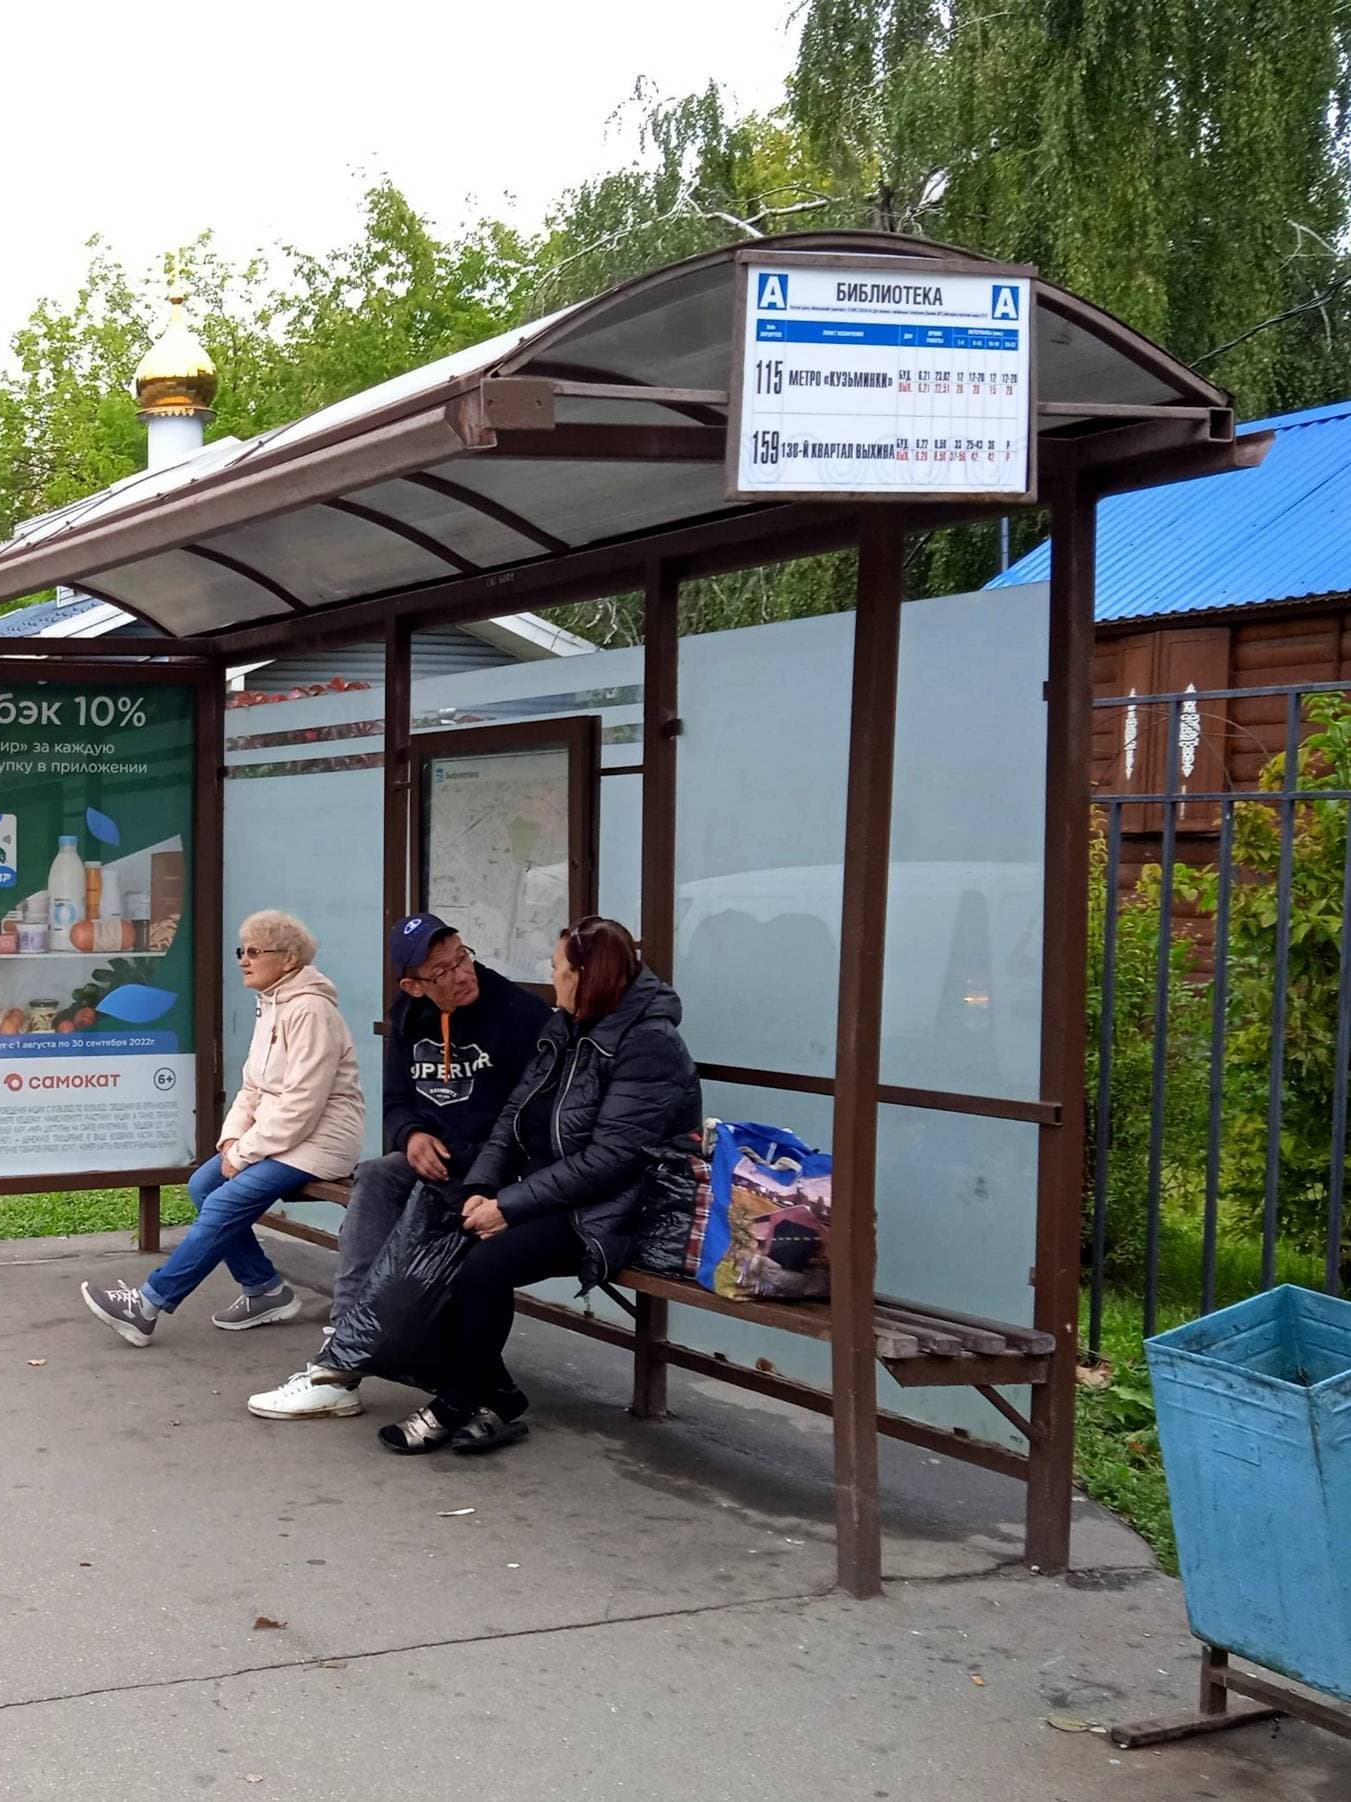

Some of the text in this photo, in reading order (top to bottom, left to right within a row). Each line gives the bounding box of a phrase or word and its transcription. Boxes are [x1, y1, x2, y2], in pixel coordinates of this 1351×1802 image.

[759, 276, 786, 309] А
[836, 283, 943, 307] БИБЛИОТЕКА
[994, 288, 1018, 318] А
[756, 360, 893, 394] 115 МЕТРО «КУЗЬМИНКИ»
[753, 430, 780, 464] 159
[811, 443, 853, 459] КВАРТАЛ
[74, 696, 147, 728] 10%
[33, 742, 49, 753] за
[54, 742, 115, 755] каждую
[38, 762, 46, 772] в
[52, 761, 148, 777] приложении
[22, 1040, 56, 1050] августа
[86, 1039, 128, 1047] сентября
[29, 1074, 120, 1089] самокат
[157, 1074, 173, 1085] 6+
